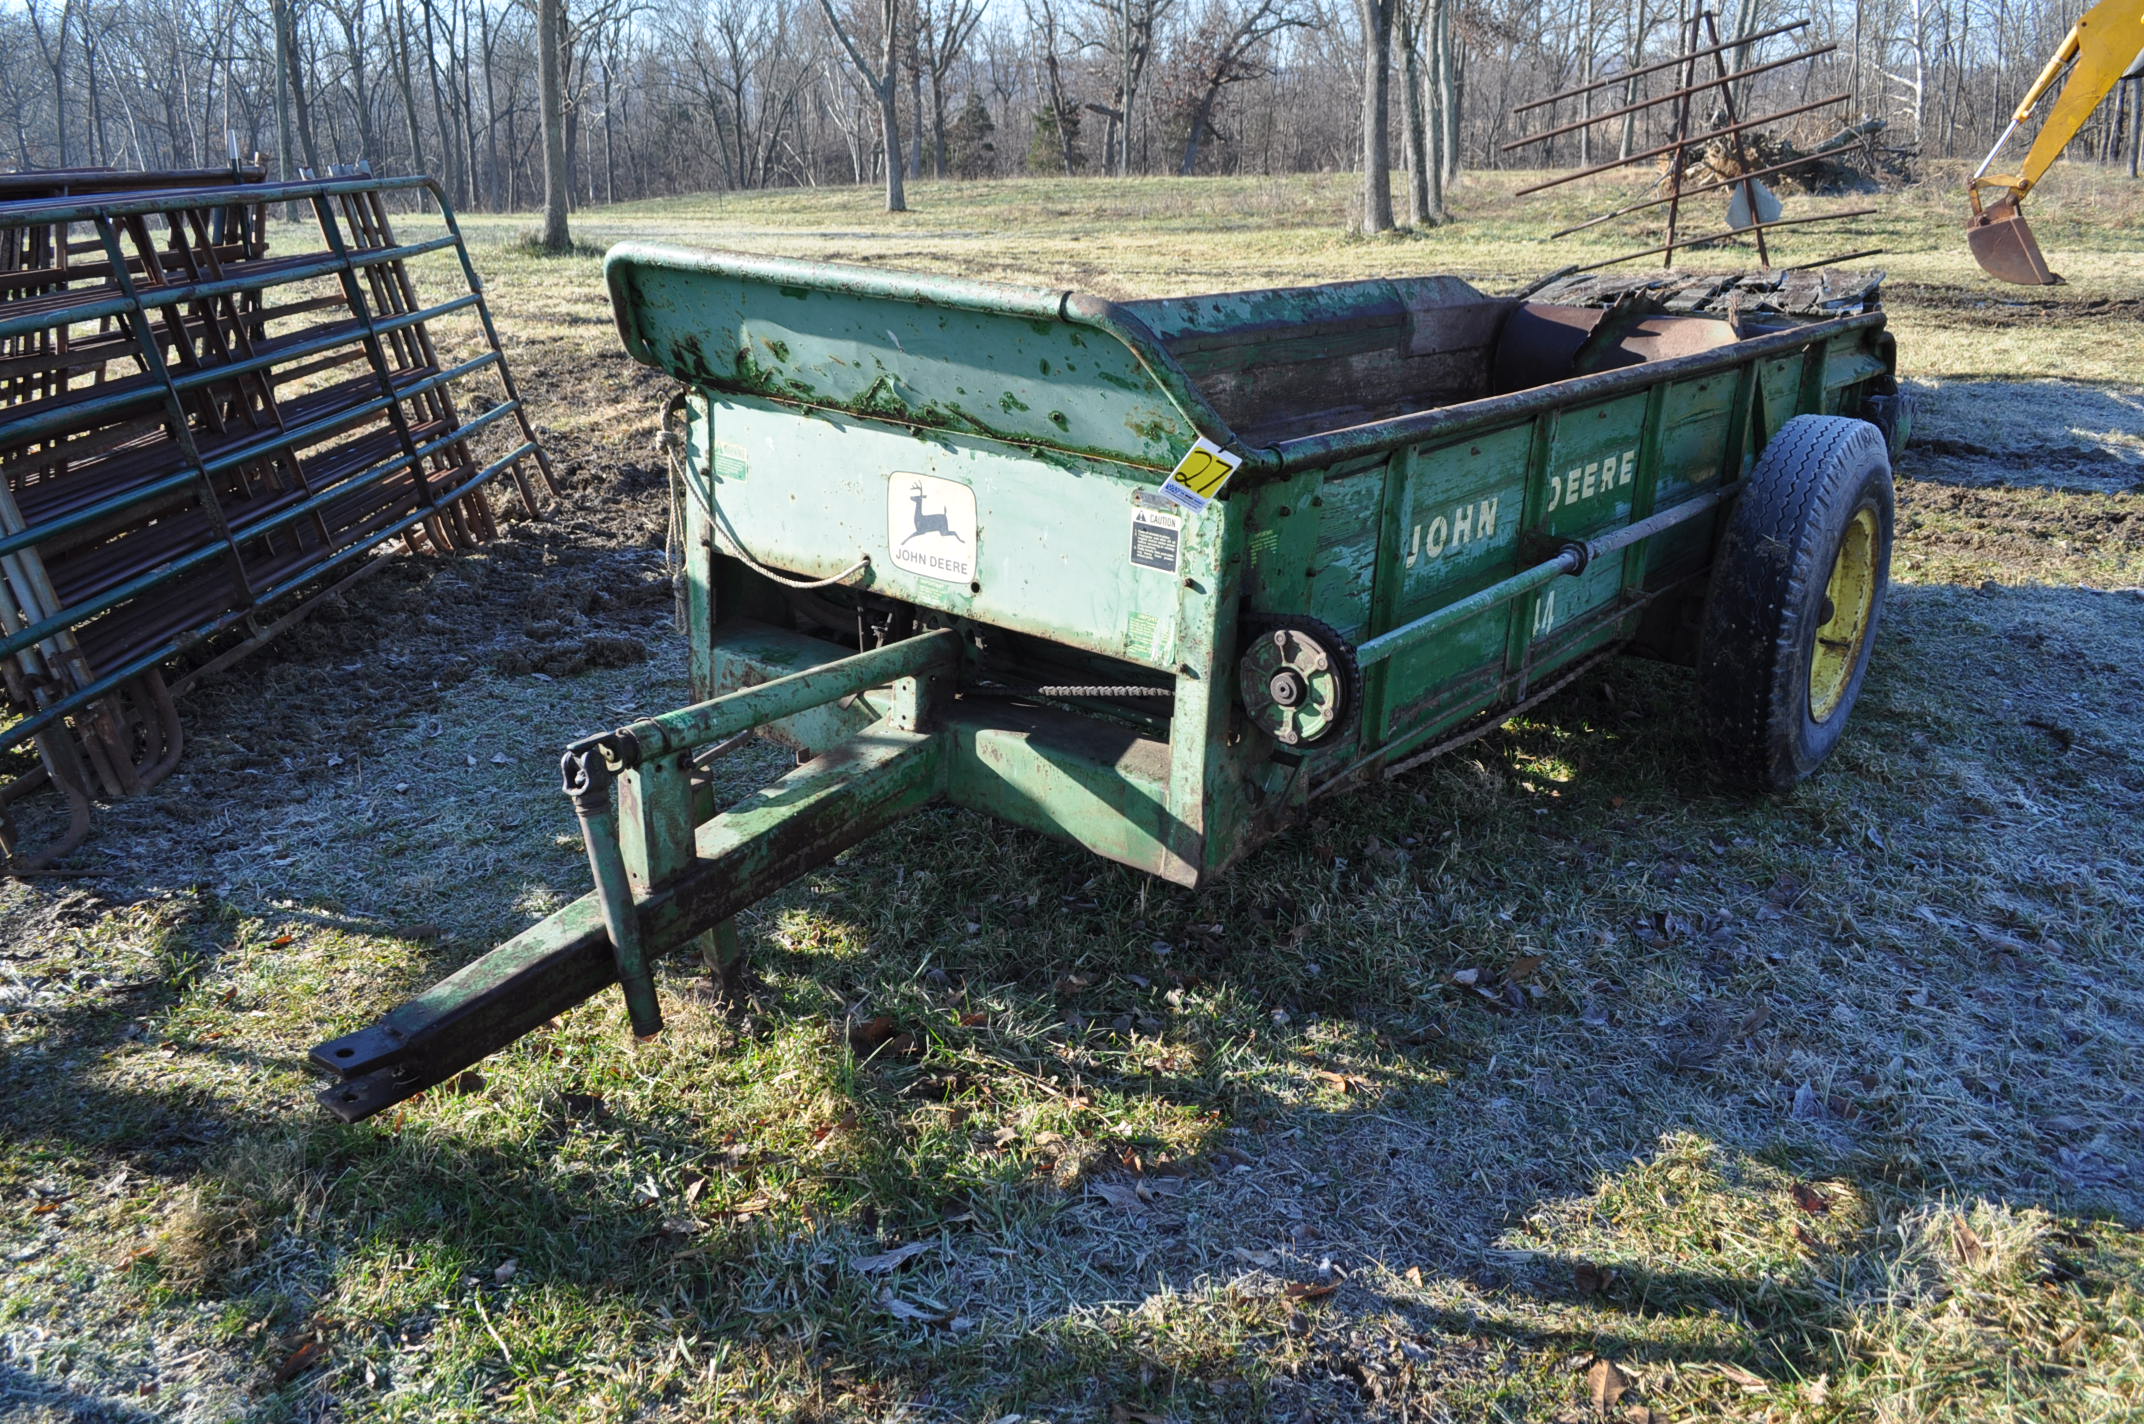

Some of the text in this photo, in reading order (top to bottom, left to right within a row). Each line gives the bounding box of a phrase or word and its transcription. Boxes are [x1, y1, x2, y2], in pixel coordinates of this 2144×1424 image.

[1174, 450, 1234, 494] 27
[1149, 513, 1177, 528] CAUTION
[1405, 450, 1636, 569] JOHN DEERE
[895, 548, 969, 575] JOHN DEERE
